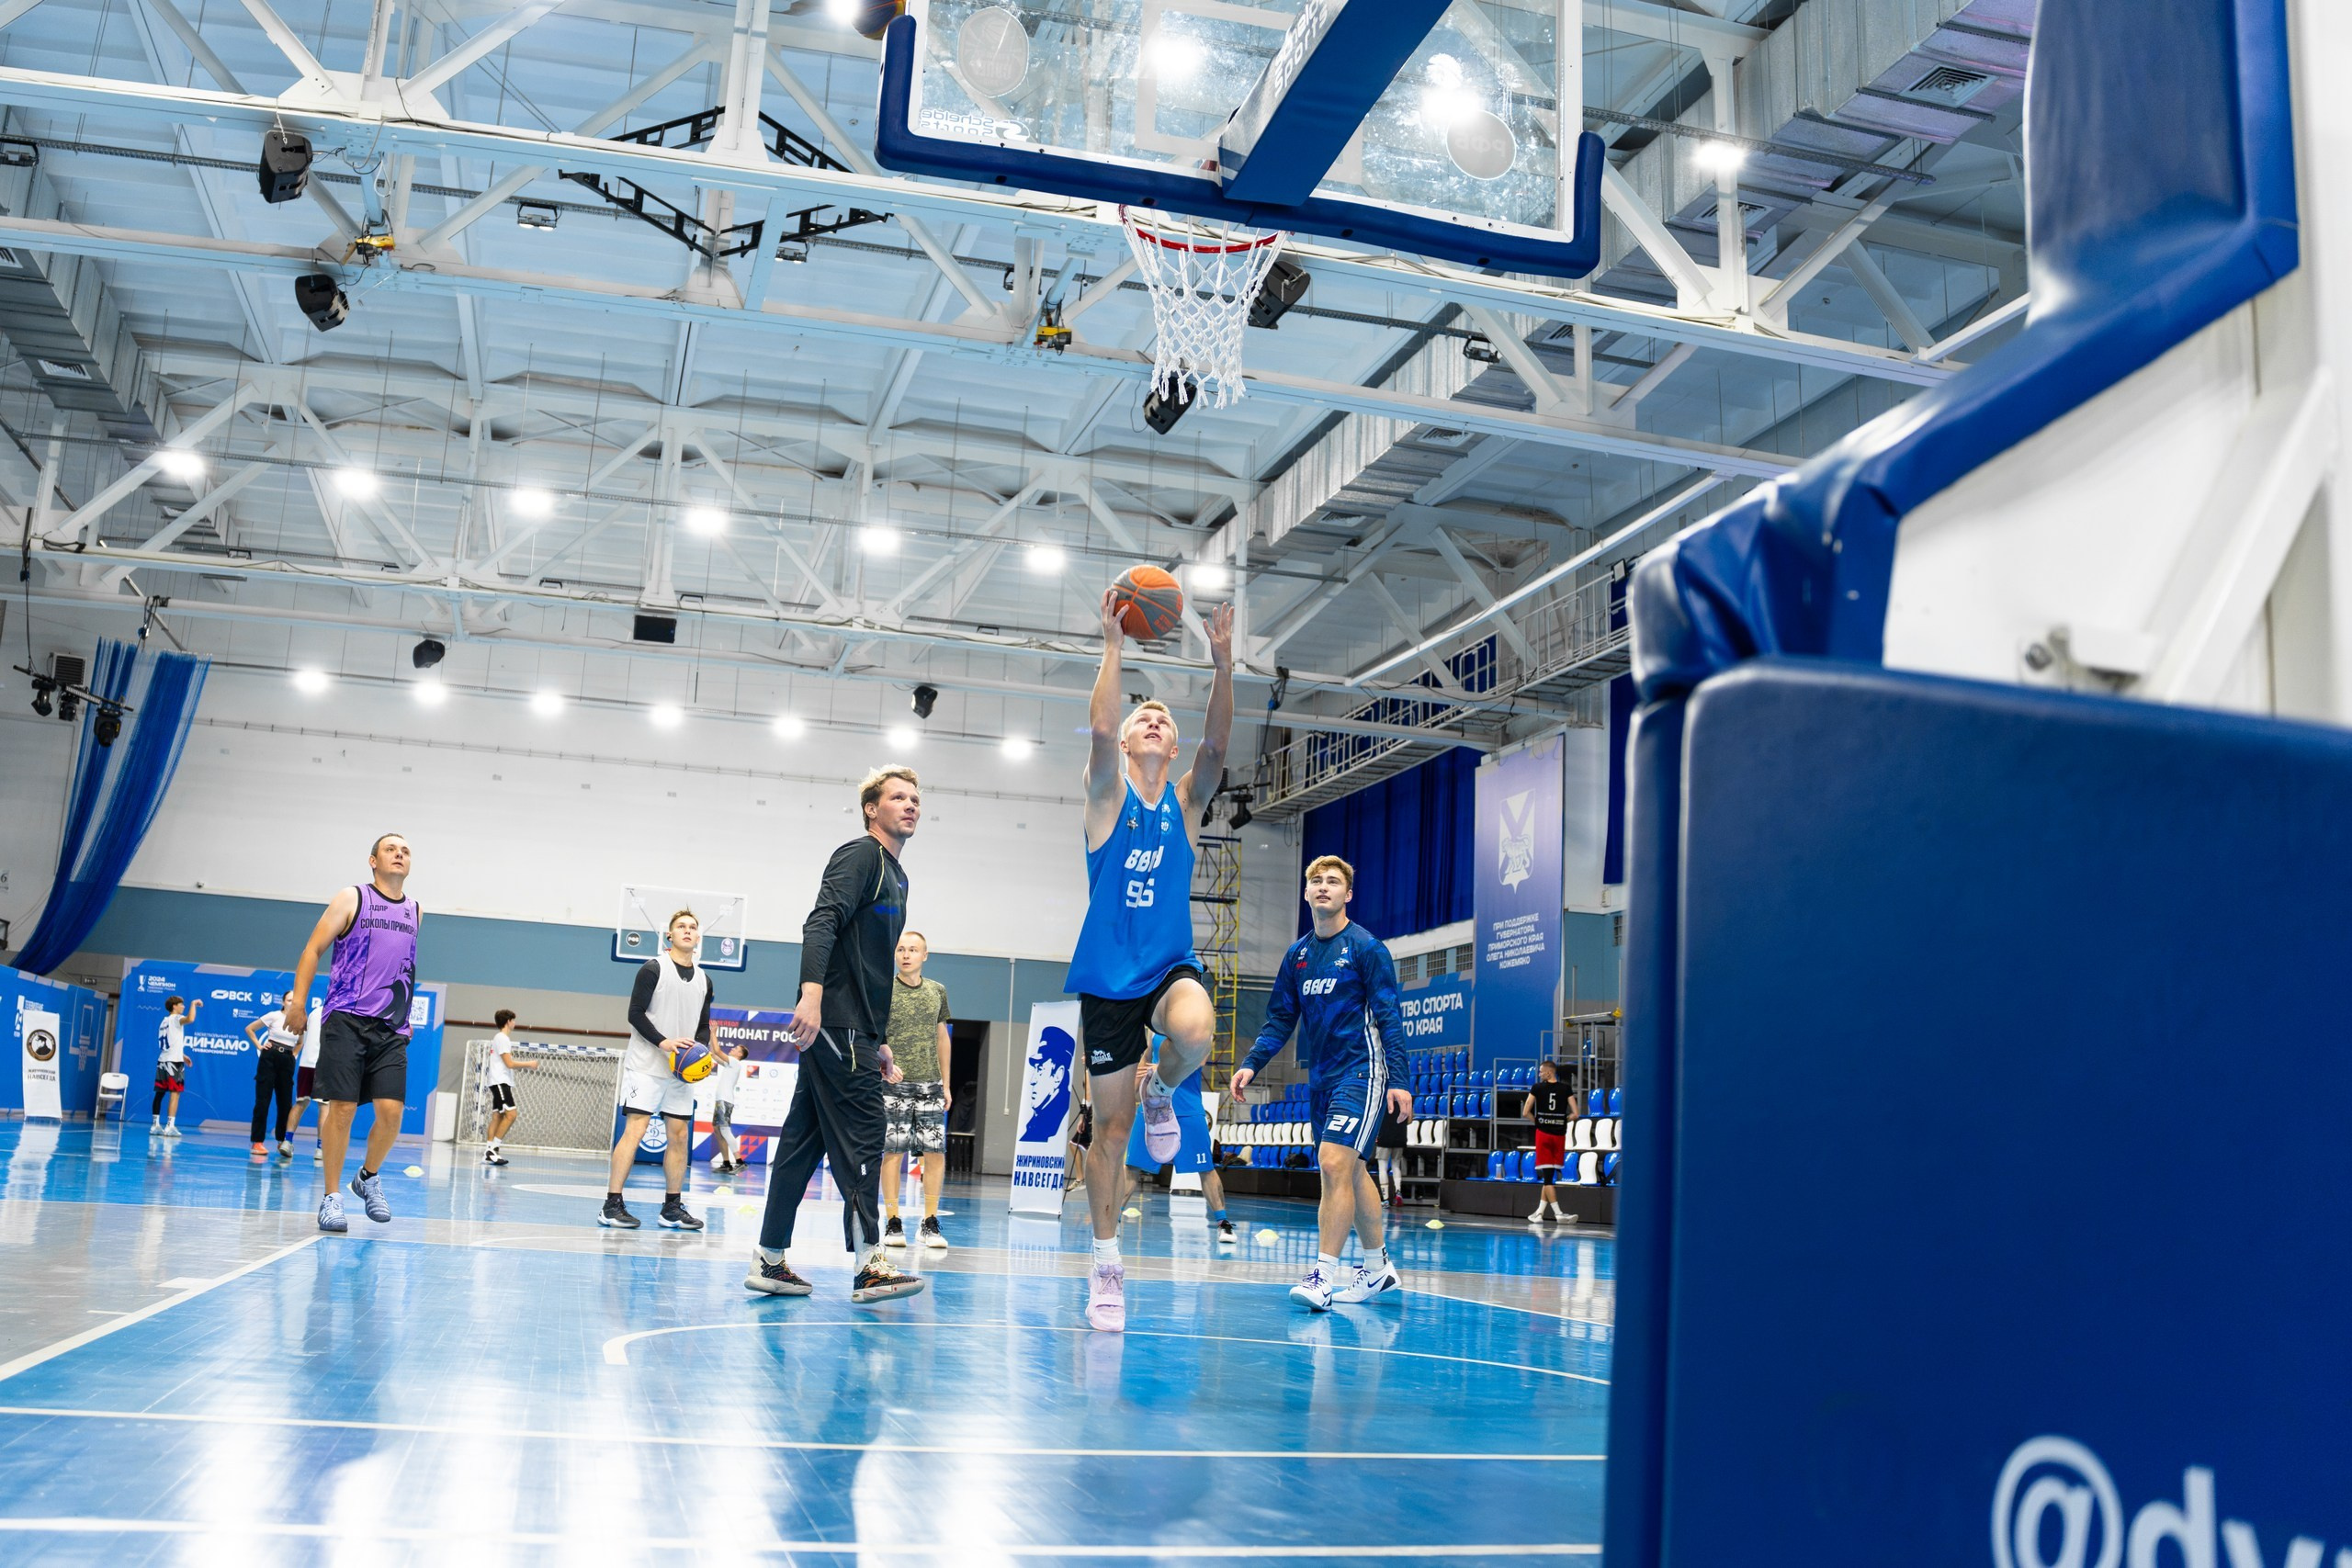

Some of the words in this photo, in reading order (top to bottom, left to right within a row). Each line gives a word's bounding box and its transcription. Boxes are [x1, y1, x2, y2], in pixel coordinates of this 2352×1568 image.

[368, 904, 389, 912] ЛДПР
[360, 919, 390, 930] СОКОЛЫ
[1493, 921, 1505, 931] ПРИ
[1504, 912, 1539, 928] ПОДДЕРЖКЕ
[1496, 924, 1535, 941] ГУБЕРНАТОРА
[1487, 936, 1528, 952] ПРИМОРСКОГО
[1528, 932, 1544, 943] КРАЯ
[1486, 952, 1504, 963] ОЛЕГА
[1504, 942, 1545, 959] НИКОЛАЕВИЧА
[1498, 955, 1531, 969] КОЖЕМЯКО
[228, 990, 253, 1002] ВСК
[1302, 978, 1338, 996] ВВГУ
[1400, 999, 1421, 1018] ТВО
[1422, 992, 1464, 1015] СПОРТА
[716, 1026, 770, 1042] ПИОНАТ
[1416, 1016, 1443, 1036] КРАЯ
[183, 1035, 250, 1052] ДИНАМО
[1549, 1093, 1556, 1111] 5
[1328, 1114, 1360, 1134] 21
[1196, 1153, 1207, 1164] 11
[1013, 1171, 1064, 1190] НАВСЕГДА
